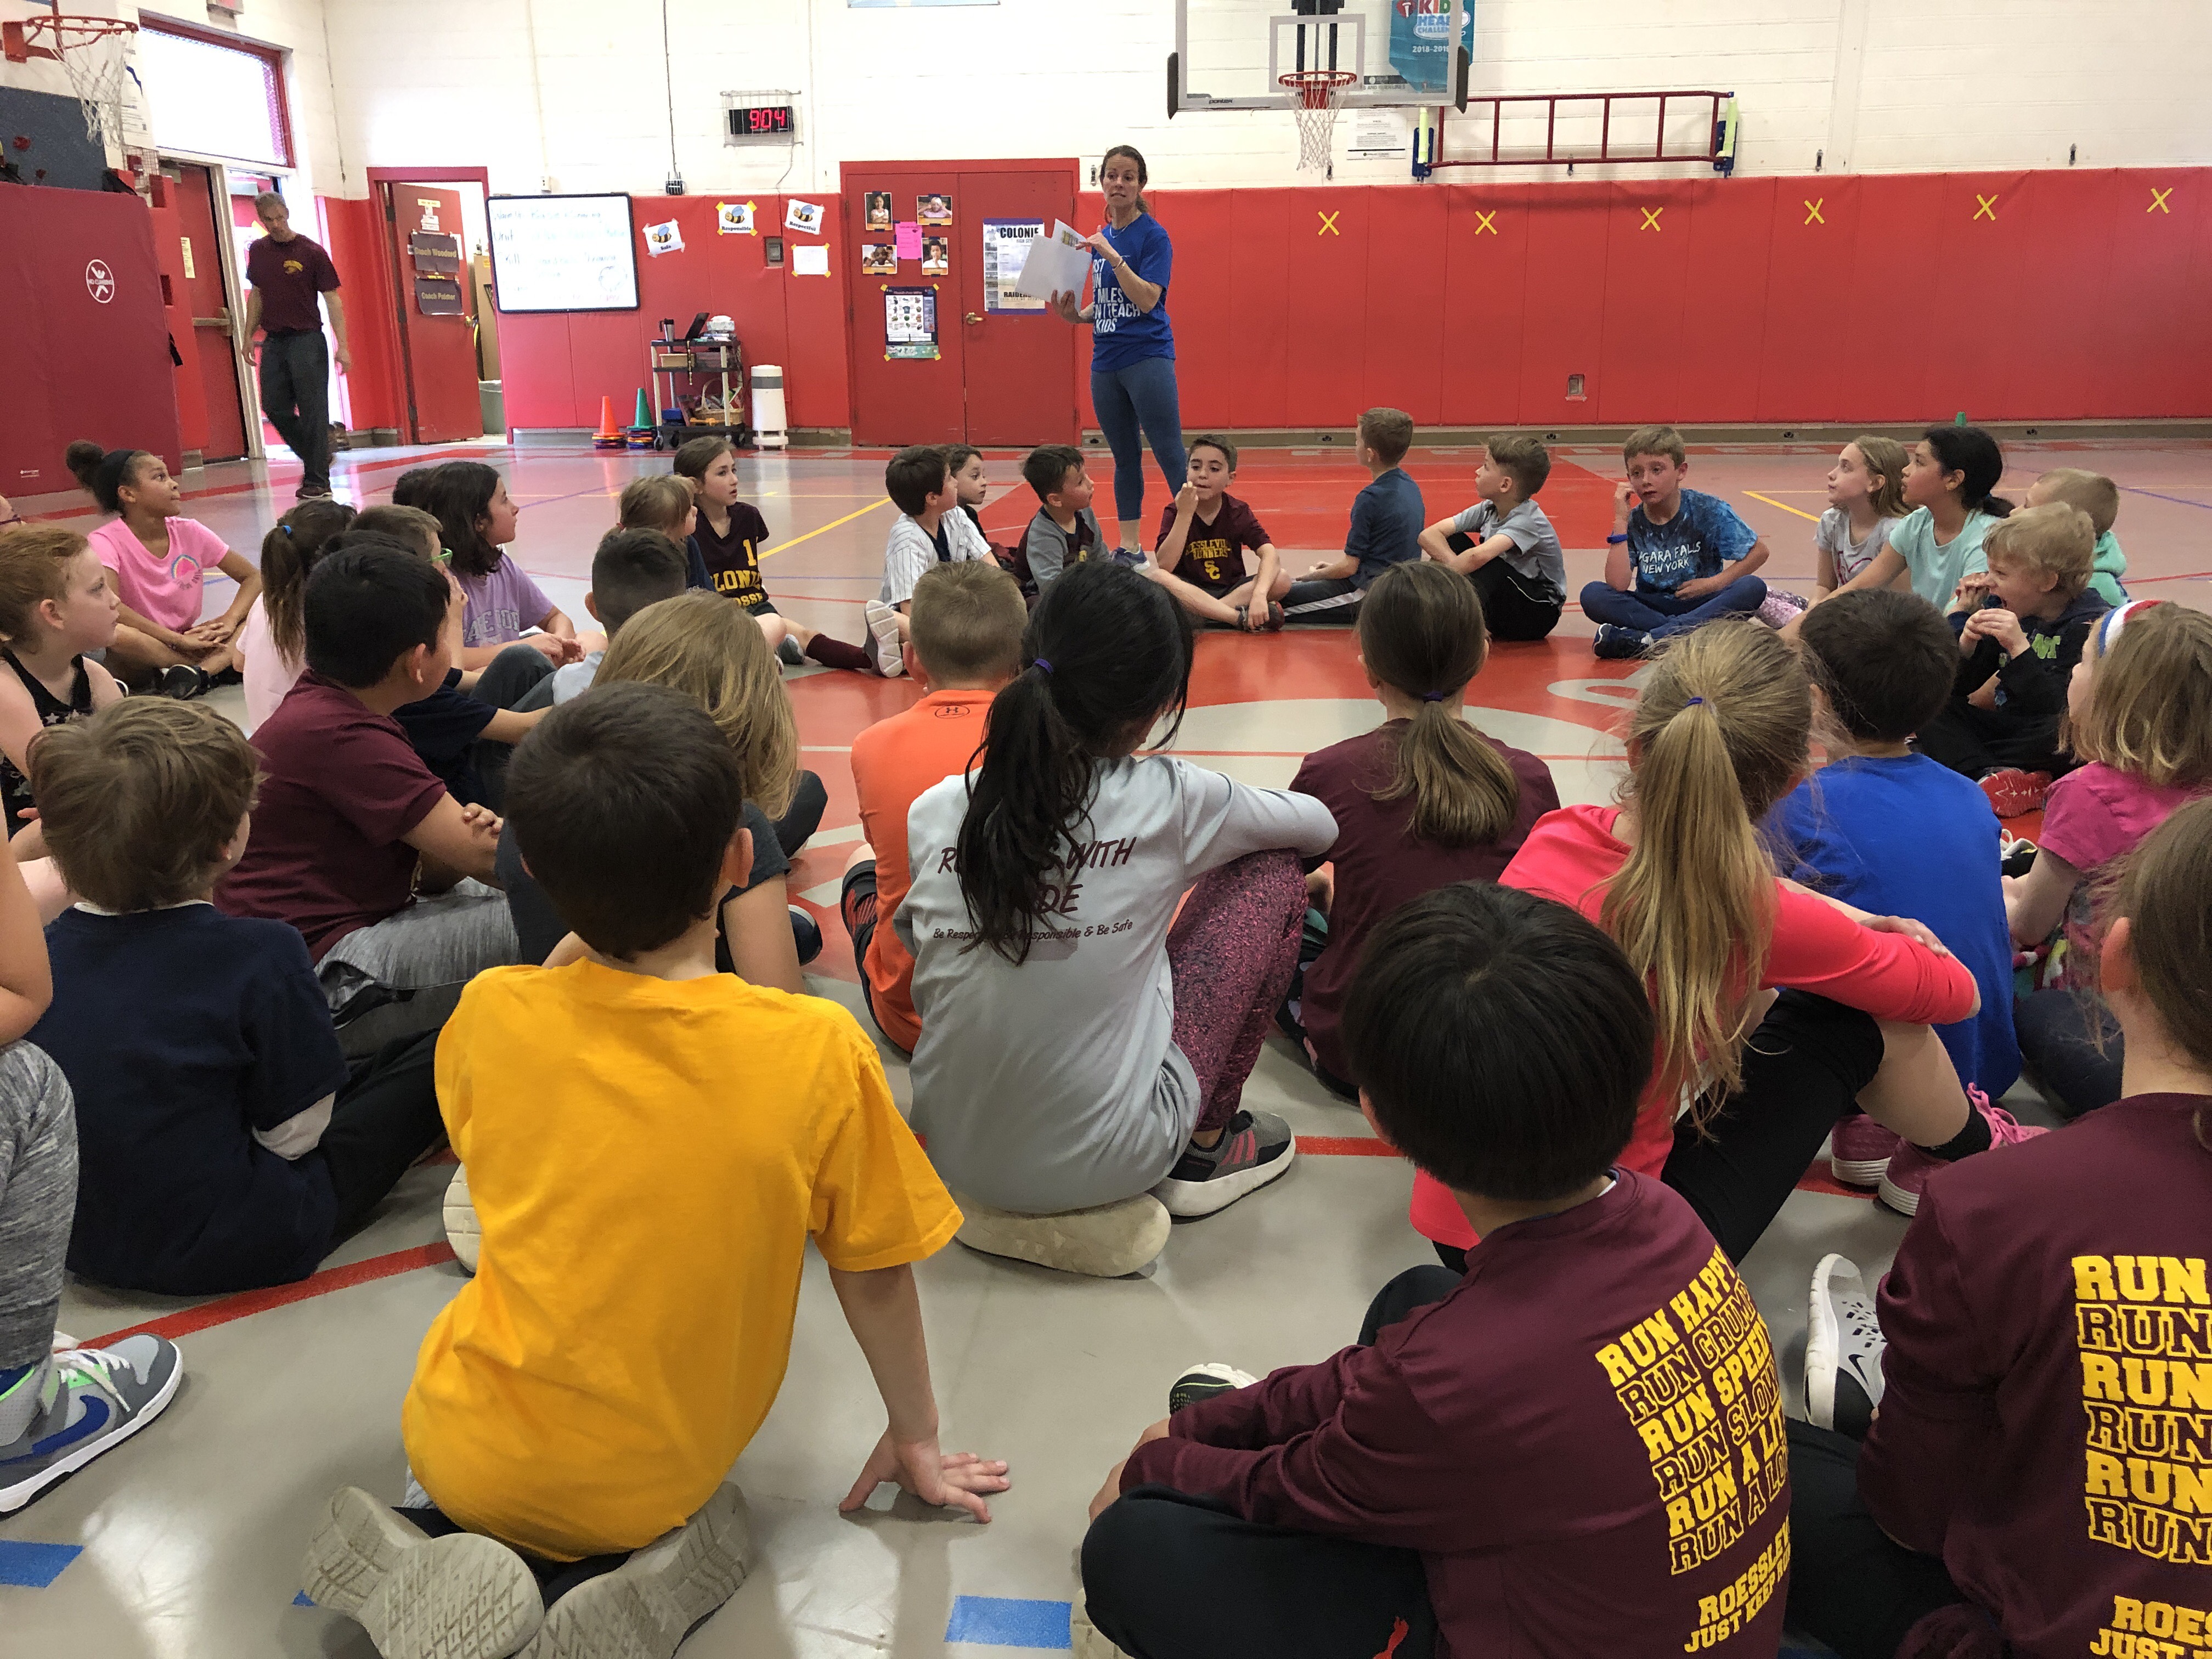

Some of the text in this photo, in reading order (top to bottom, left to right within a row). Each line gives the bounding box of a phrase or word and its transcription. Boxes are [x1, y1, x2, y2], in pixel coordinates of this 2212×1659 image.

[1418, 0, 1451, 14] KID
[789, 221, 816, 231] Respectful
[1098, 287, 1124, 303] MILES
[1107, 303, 1141, 318] TEACH
[1096, 318, 1118, 334] KIDS
[743, 537, 758, 566] 1
[1642, 557, 1689, 574] NEW YORK
[1674, 541, 1701, 558] FALLS
[1065, 837, 1137, 870] WITH
[933, 928, 944, 938] Be
[1084, 926, 1094, 937] &
[1097, 924, 1110, 935] Be
[1112, 919, 1133, 934] Safe
[2072, 1255, 2211, 1305] RUN
[1595, 1308, 1680, 1387] RUN
[1616, 1278, 1756, 1426] RUN GRUMP
[2075, 1302, 2212, 1359] RUN
[2080, 1351, 2212, 1410] RUN
[1638, 1383, 1716, 1463] RUN
[2083, 1400, 2212, 1464] RUN
[1652, 1419, 1730, 1502] RUN
[2085, 1449, 2212, 1515] RUN
[1666, 1460, 1737, 1537] RUN
[1741, 1440, 1759, 1485] A
[1669, 1498, 1745, 1576] RUN
[1748, 1477, 1767, 1525] A
[2085, 1496, 2212, 1565] RUN
[1684, 1609, 1742, 1653] JUST
[1746, 1571, 1776, 1623] KEEP
[2090, 1628, 2185, 1659] JUST
